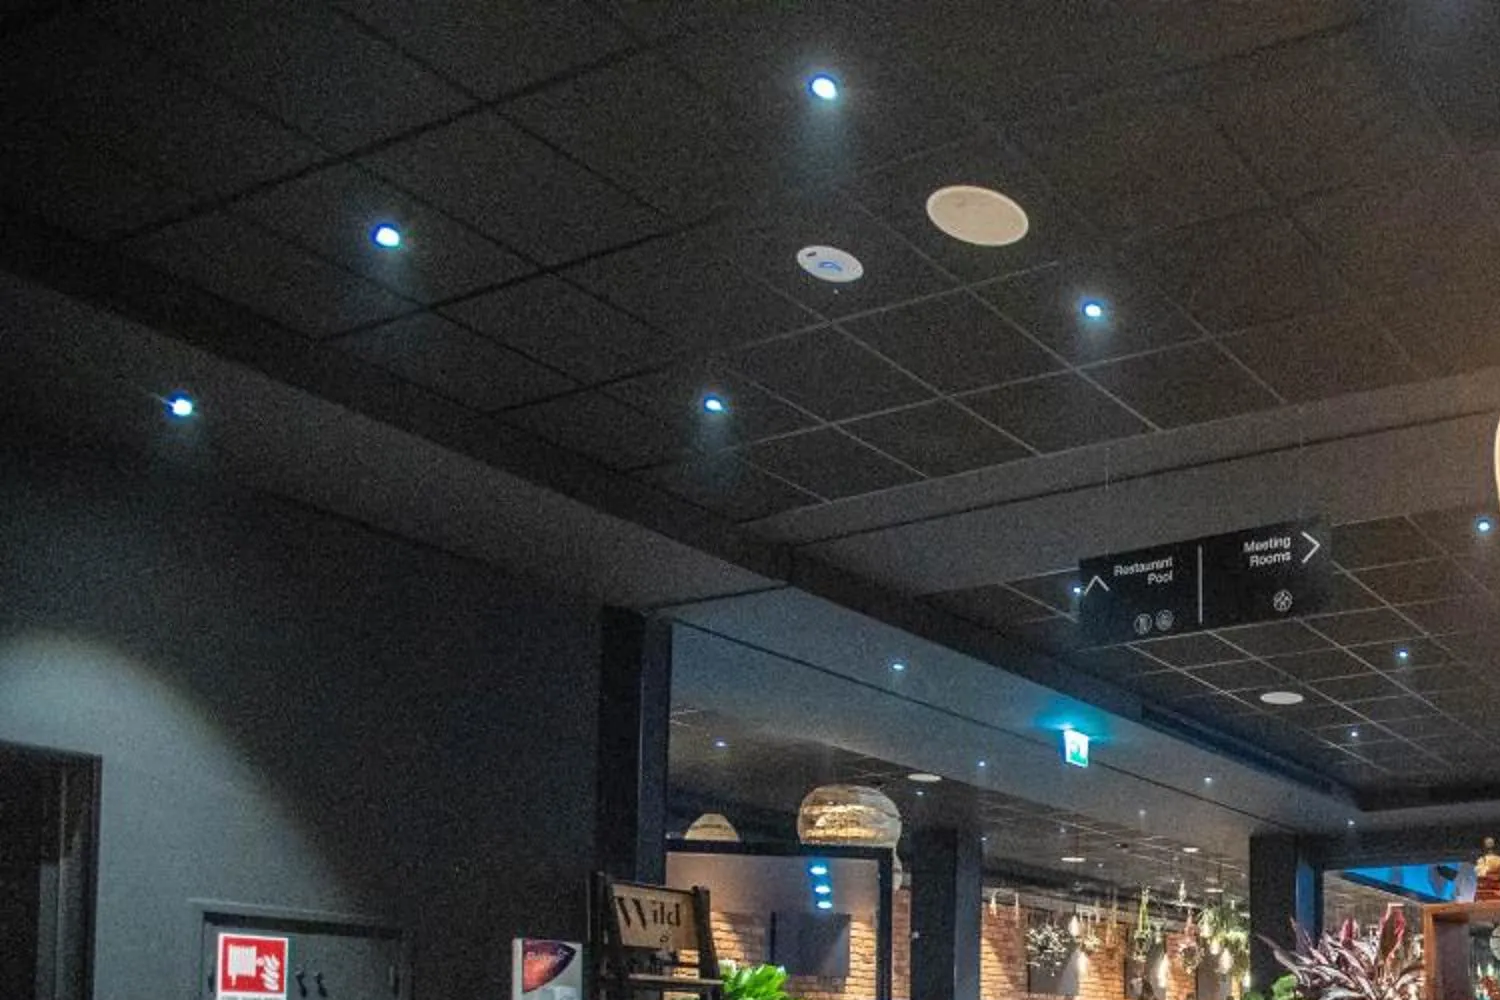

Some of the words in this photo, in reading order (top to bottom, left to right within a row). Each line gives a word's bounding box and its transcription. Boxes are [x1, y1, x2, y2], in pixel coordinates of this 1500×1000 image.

[1243, 536, 1291, 553] Meeting
[1113, 556, 1173, 576] Restaurant
[1249, 551, 1291, 567] Rooms
[1147, 570, 1173, 584] Pool
[614, 897, 681, 929] Wild
